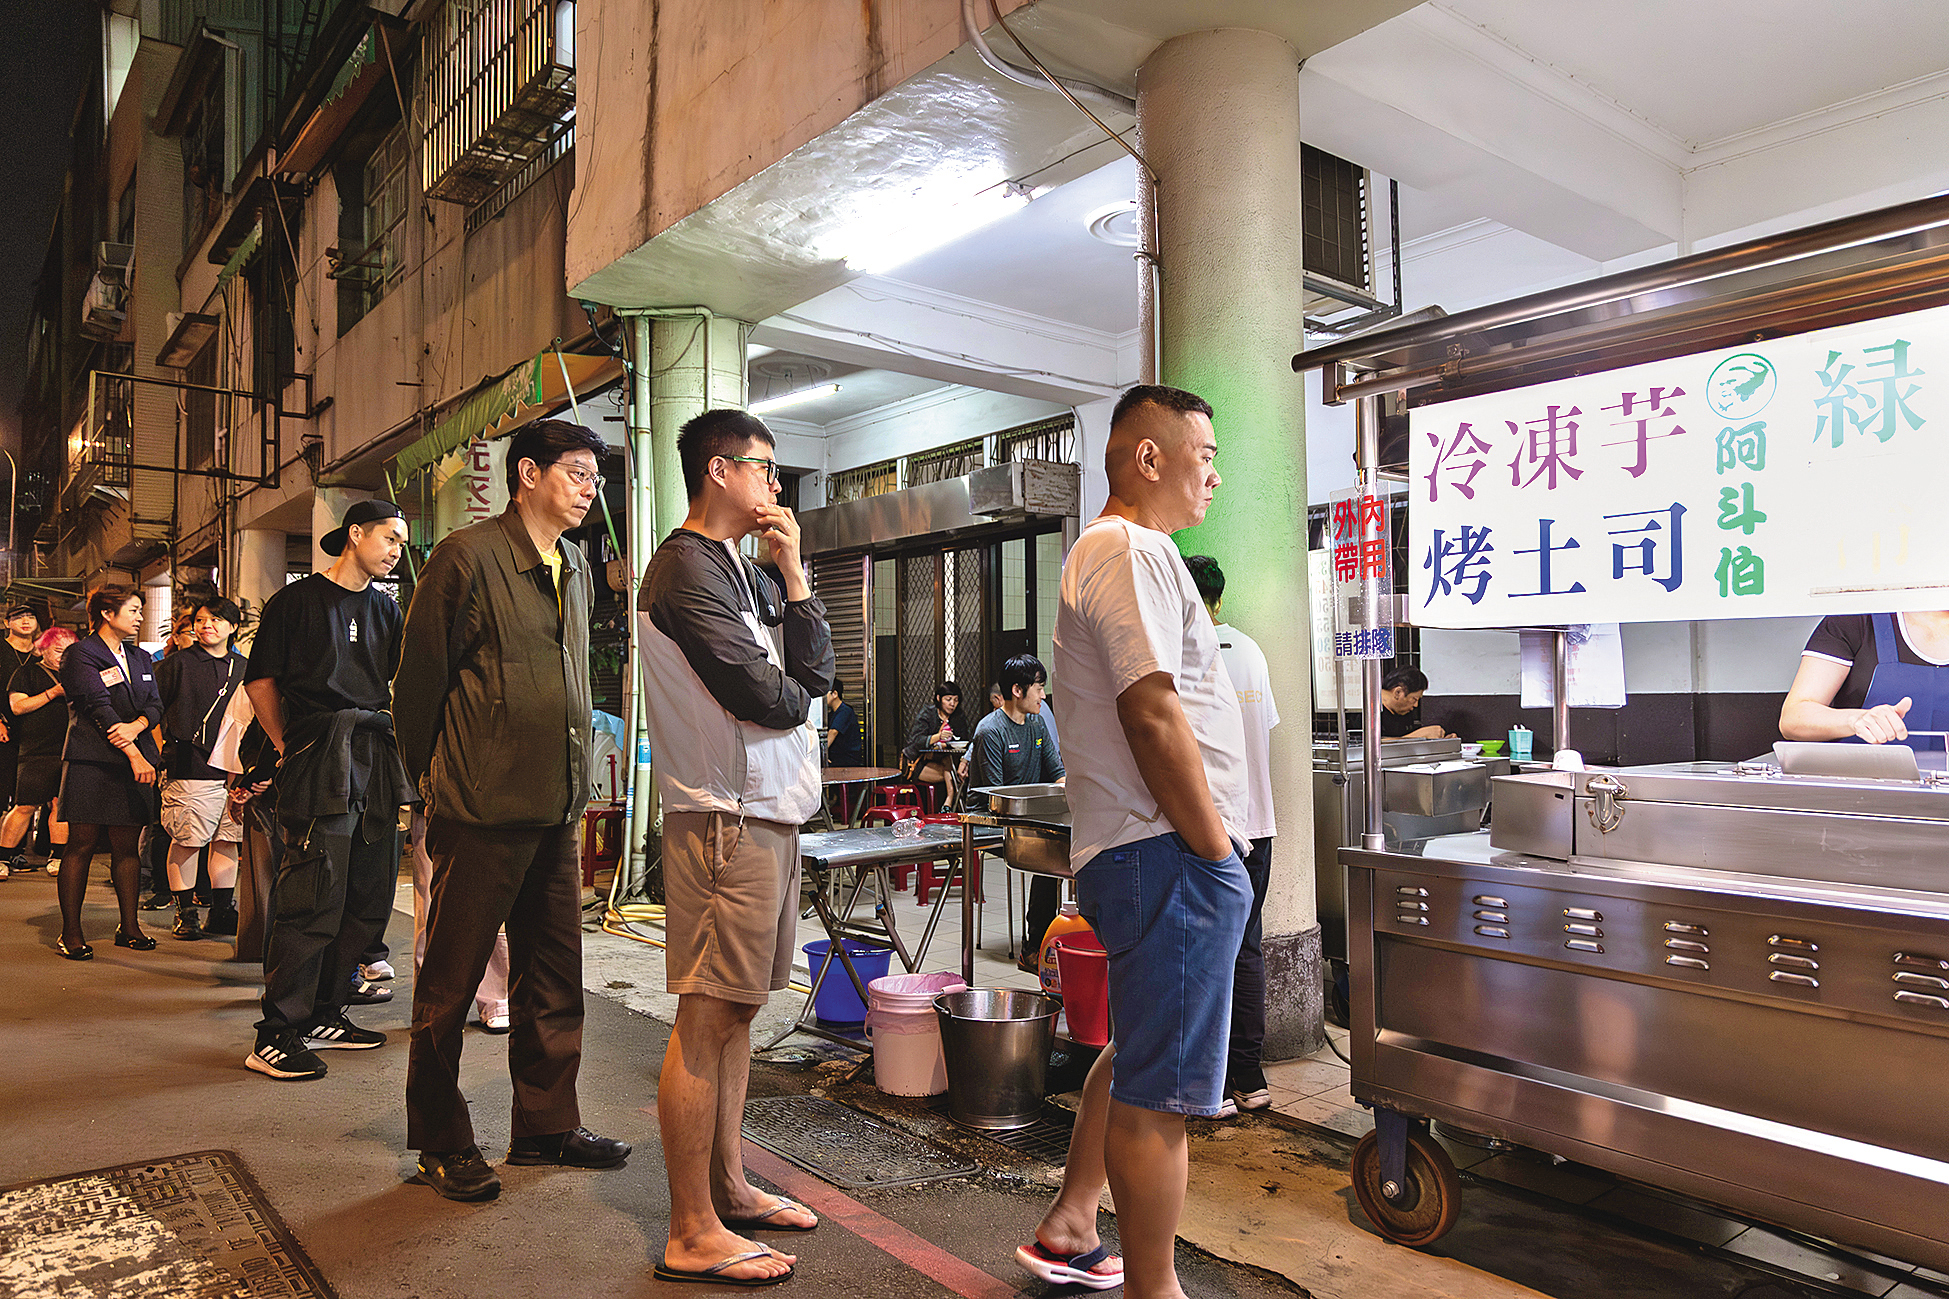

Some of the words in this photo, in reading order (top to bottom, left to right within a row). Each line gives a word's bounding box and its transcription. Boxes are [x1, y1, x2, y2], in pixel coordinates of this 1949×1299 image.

[1424, 386, 1687, 503] 冷凍芋
[1333, 497, 1359, 584] 外帶
[1423, 502, 1688, 608] 烤土司
[1714, 420, 1768, 599] 阿斗伯
[1335, 627, 1391, 657] 請排隊
